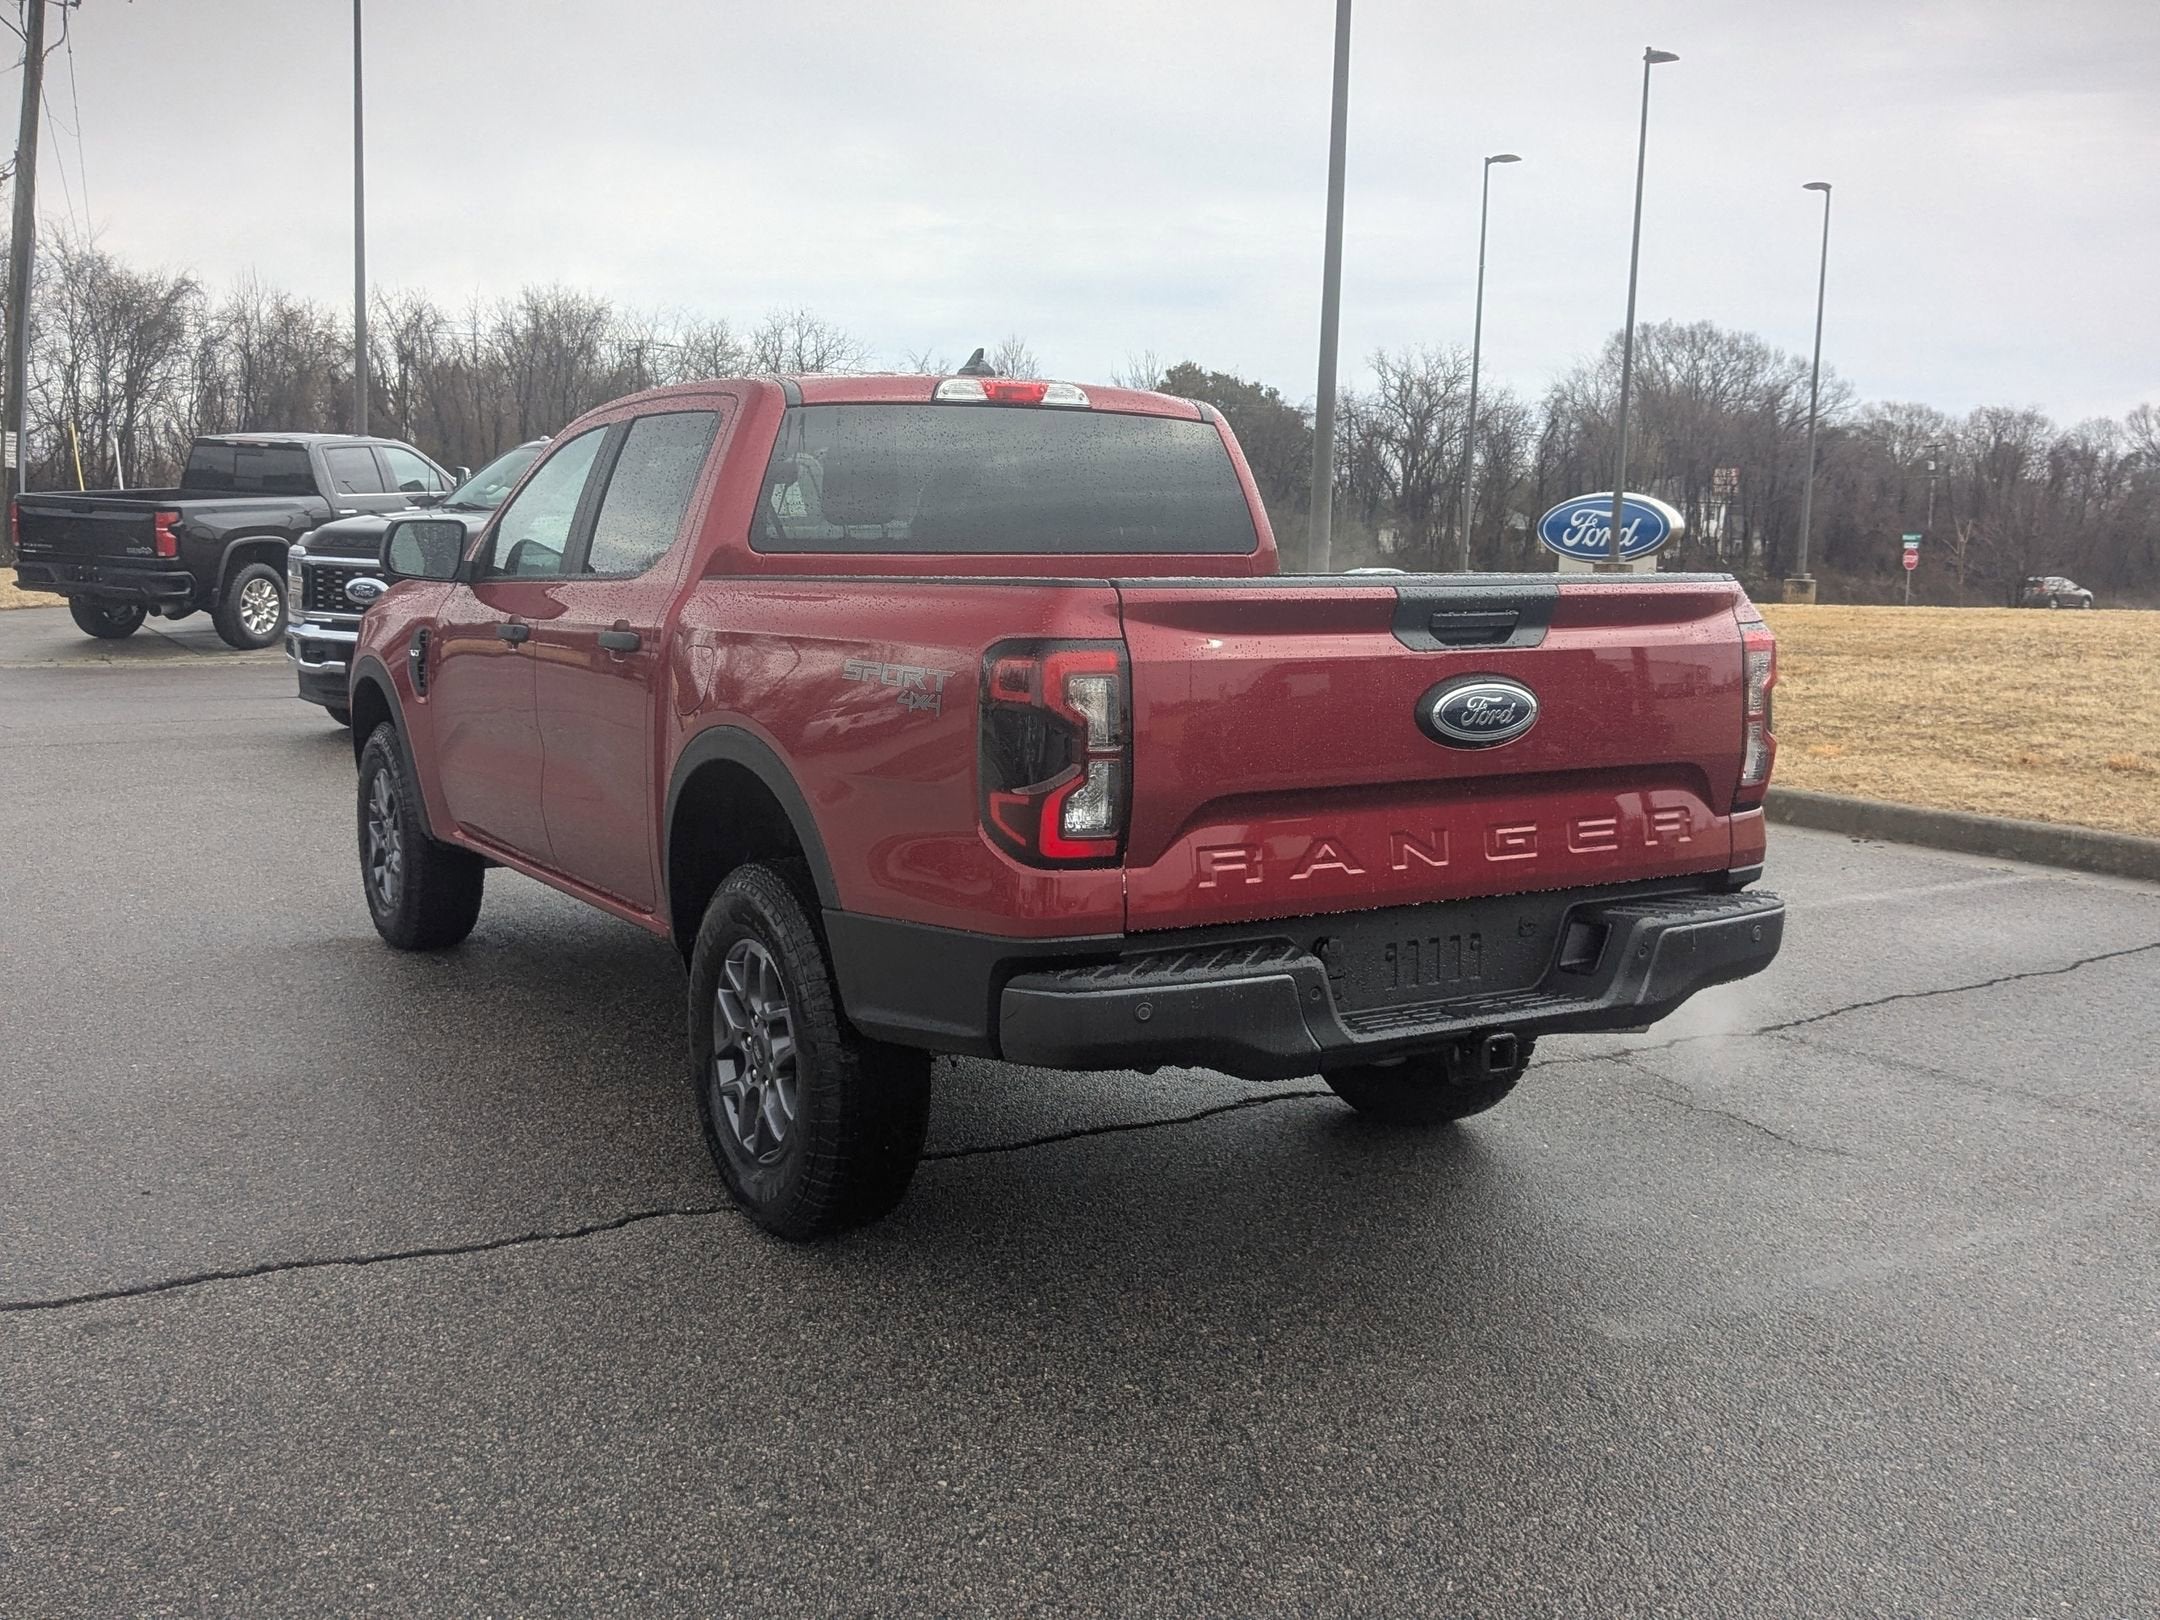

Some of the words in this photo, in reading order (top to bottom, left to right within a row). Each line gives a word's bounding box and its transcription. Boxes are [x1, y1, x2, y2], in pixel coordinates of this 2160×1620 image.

[1562, 508, 1643, 548] Ford
[841, 658, 956, 692] SPORT
[1460, 695, 1517, 727] Ford
[1196, 805, 1692, 889] RANGER
